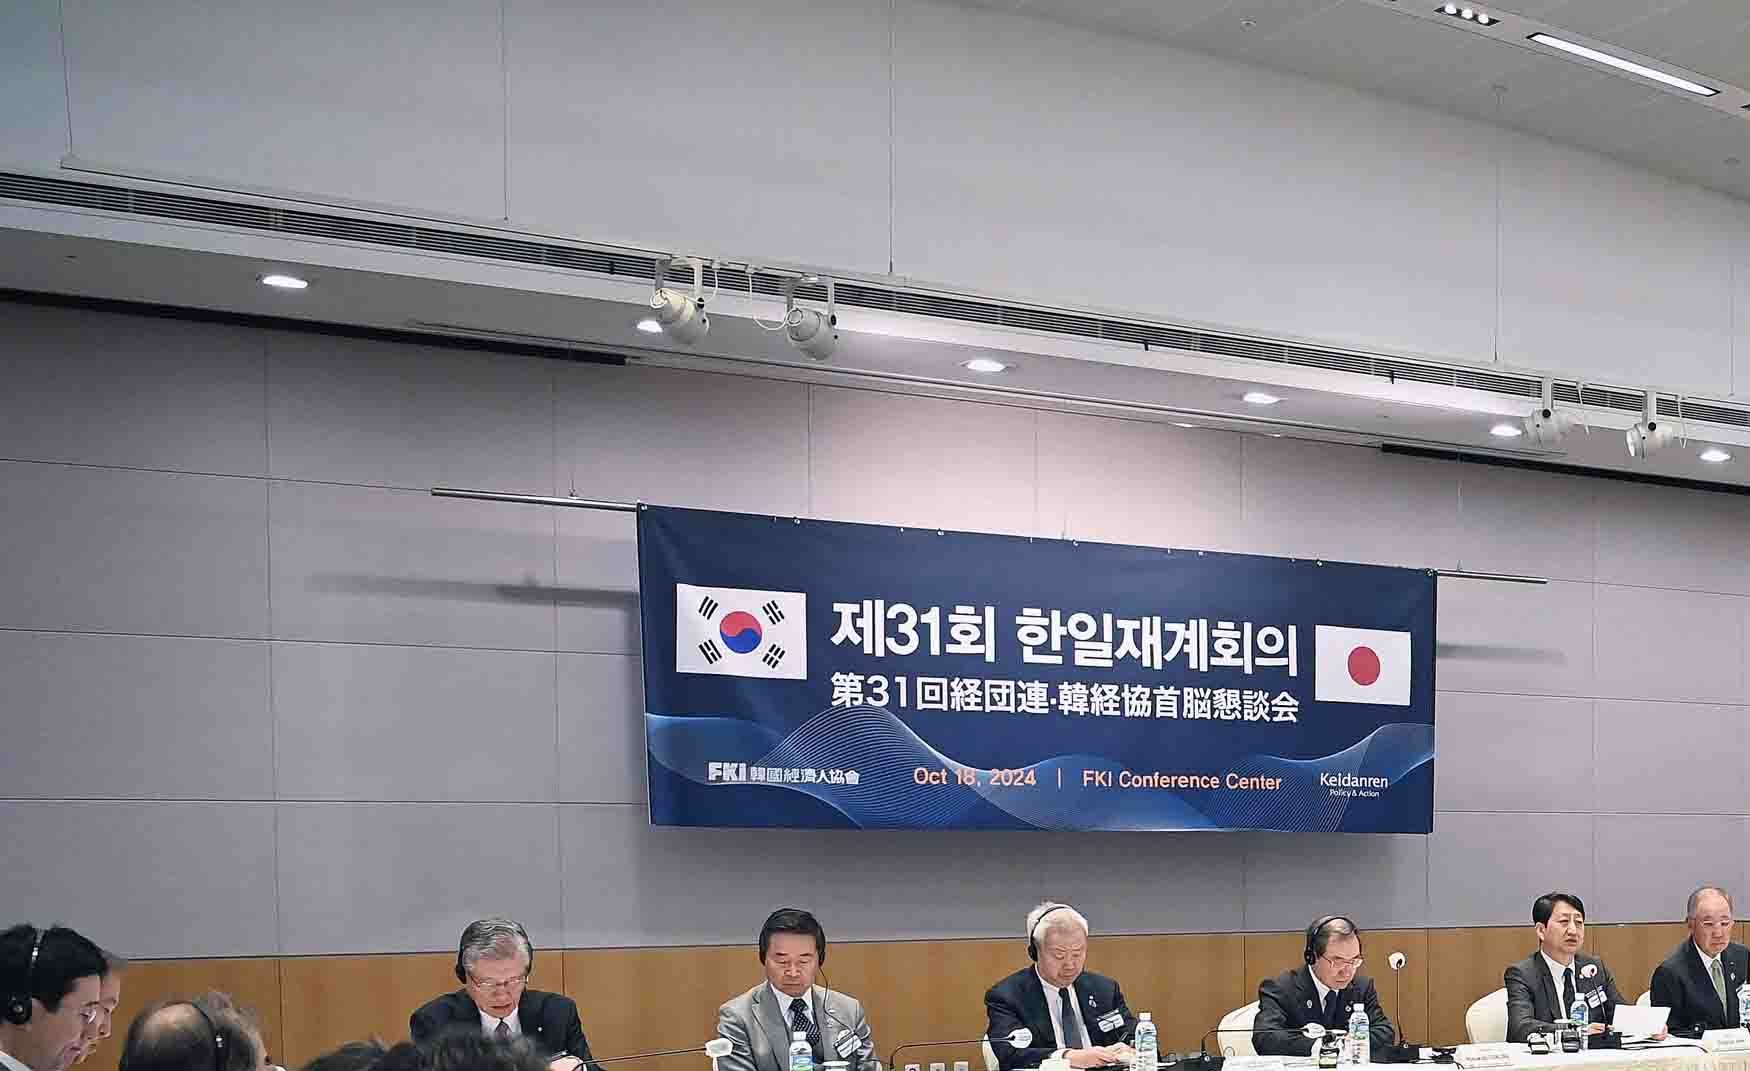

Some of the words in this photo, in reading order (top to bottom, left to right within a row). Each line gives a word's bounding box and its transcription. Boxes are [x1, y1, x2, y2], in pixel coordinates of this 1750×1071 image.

[830, 599, 996, 663] 제31회
[1015, 606, 1298, 677] 한일재계회의
[708, 762, 747, 781] FKI
[914, 767, 947, 784] Oct
[957, 768, 981, 787] 18,
[990, 768, 1037, 785] 2024
[1083, 770, 1112, 787] FKI
[1119, 771, 1220, 788] Conference
[1226, 773, 1282, 790] Center
[1320, 772, 1389, 788] Keidanren
